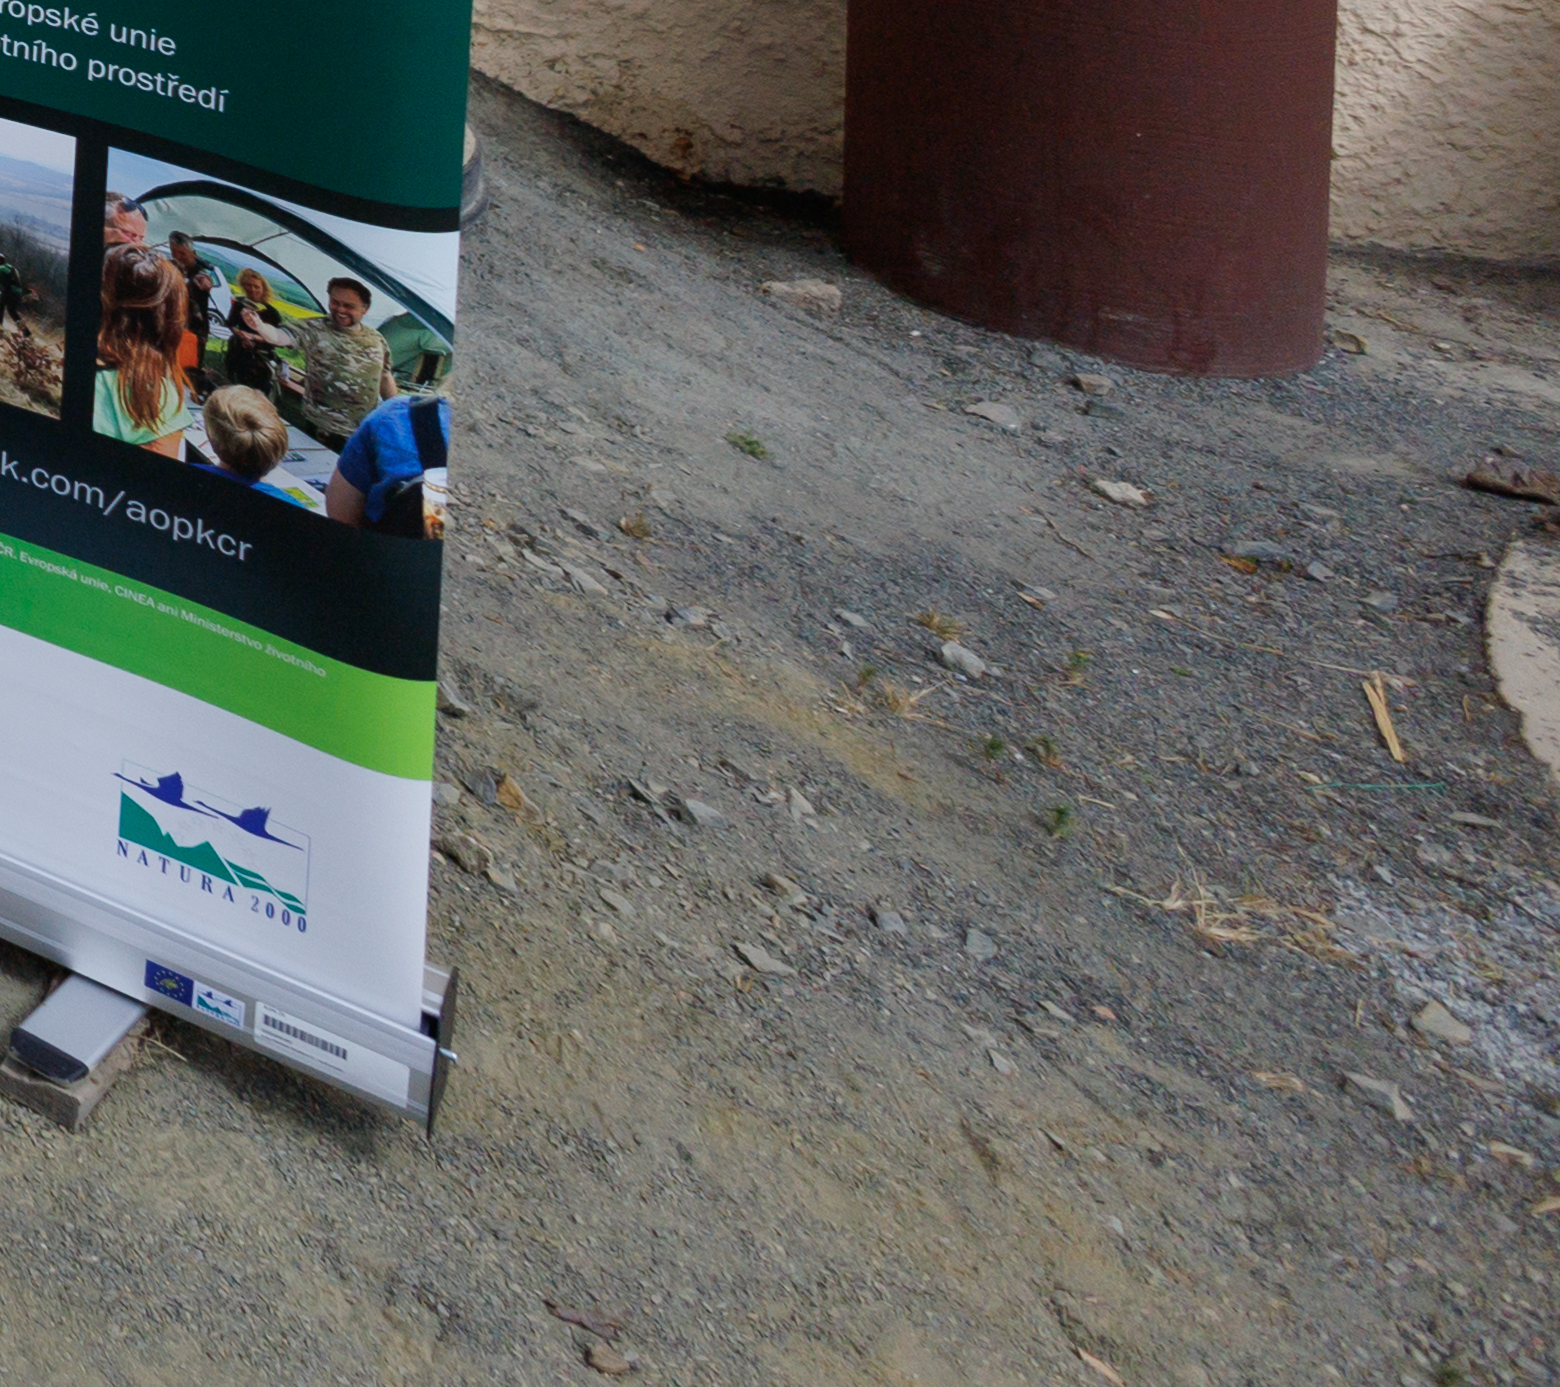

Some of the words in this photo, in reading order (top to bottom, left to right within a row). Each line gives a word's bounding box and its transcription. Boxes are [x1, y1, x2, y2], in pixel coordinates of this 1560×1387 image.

[109, 23, 177, 56] unie
[87, 58, 229, 113] prostředí
[114, 584, 156, 609] CINEA
[180, 609, 264, 651] Ministerstvo
[116, 838, 236, 904] NATURA
[250, 894, 308, 934] 2000
